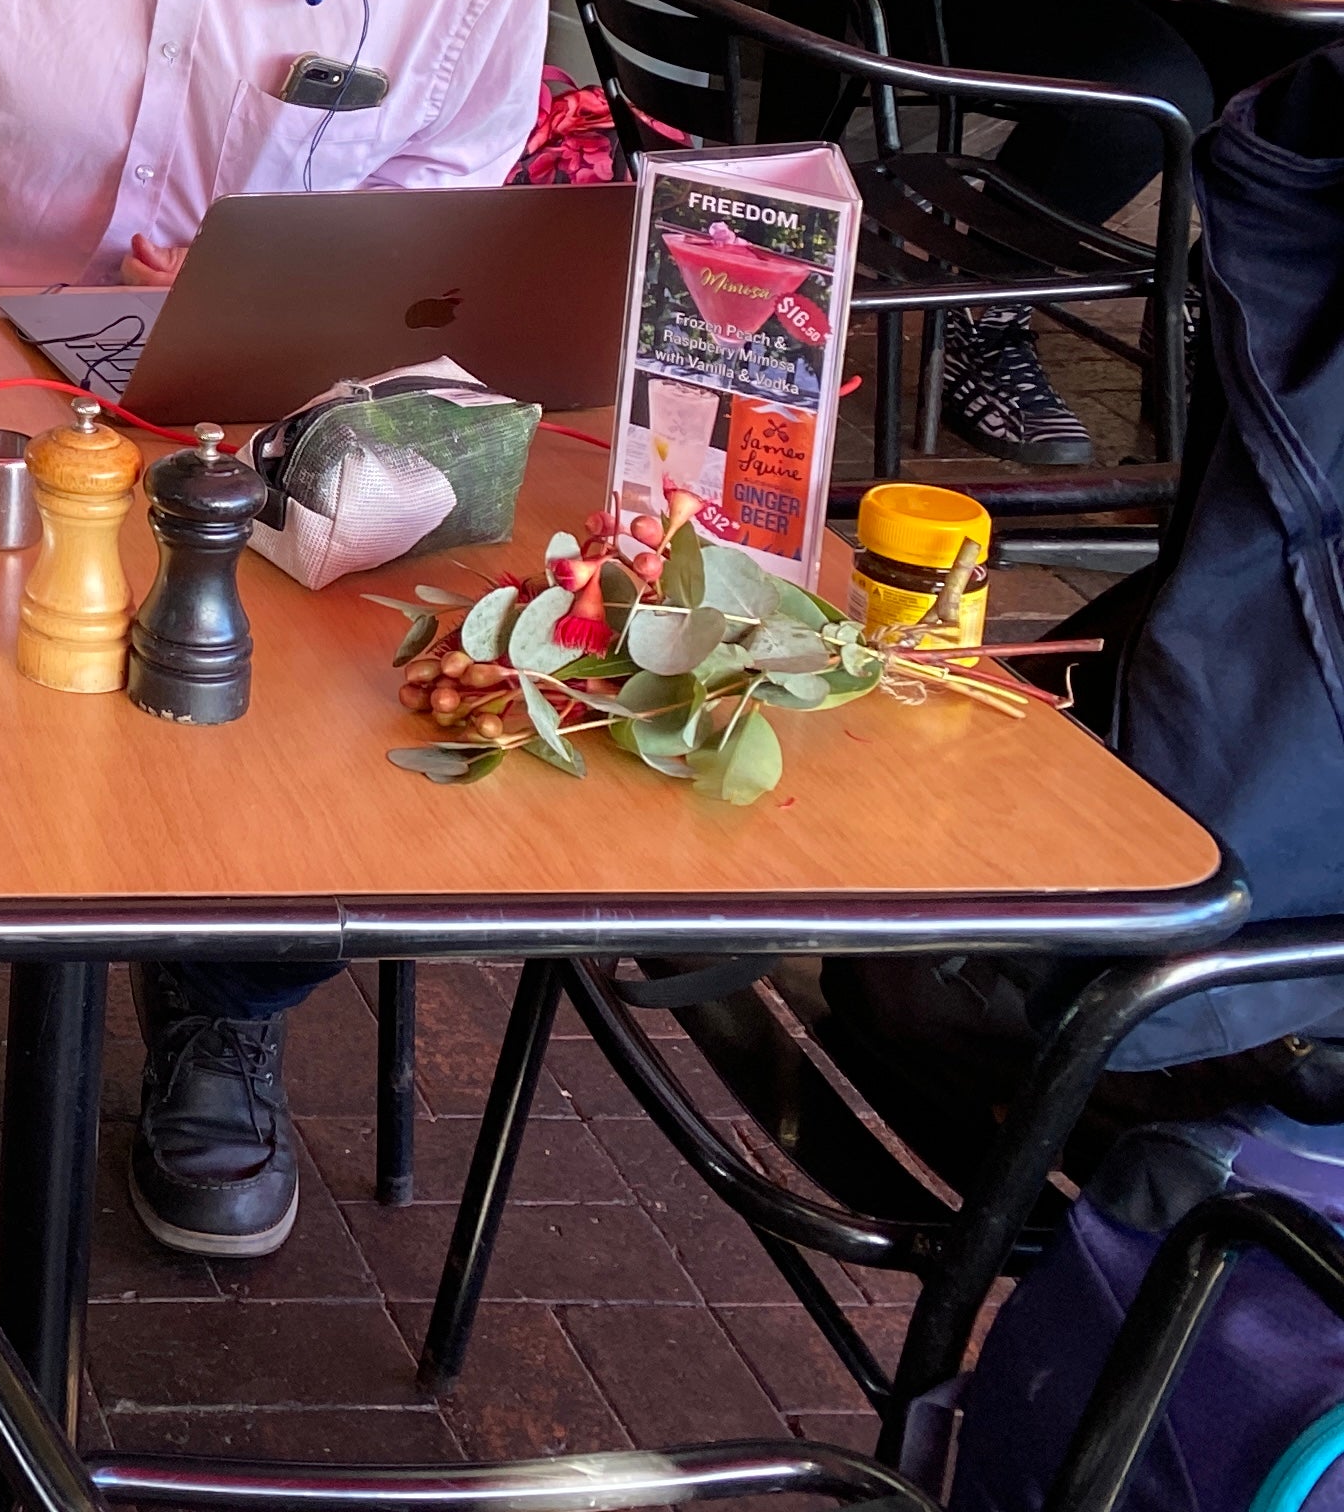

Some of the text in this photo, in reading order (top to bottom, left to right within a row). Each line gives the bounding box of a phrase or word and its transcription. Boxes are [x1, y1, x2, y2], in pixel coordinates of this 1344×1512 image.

[688, 192, 799, 230] FREEDOM
[700, 267, 772, 300] Mimosa
[676, 312, 788, 351] Frozen Peach &
[663, 329, 796, 373] Raspberry Mimosa
[655, 350, 800, 395] with Vanilla & Vodka
[740, 426, 805, 460] James
[738, 450, 803, 481] Squire
[734, 483, 800, 519] GINGER
[741, 504, 789, 536] BEER
